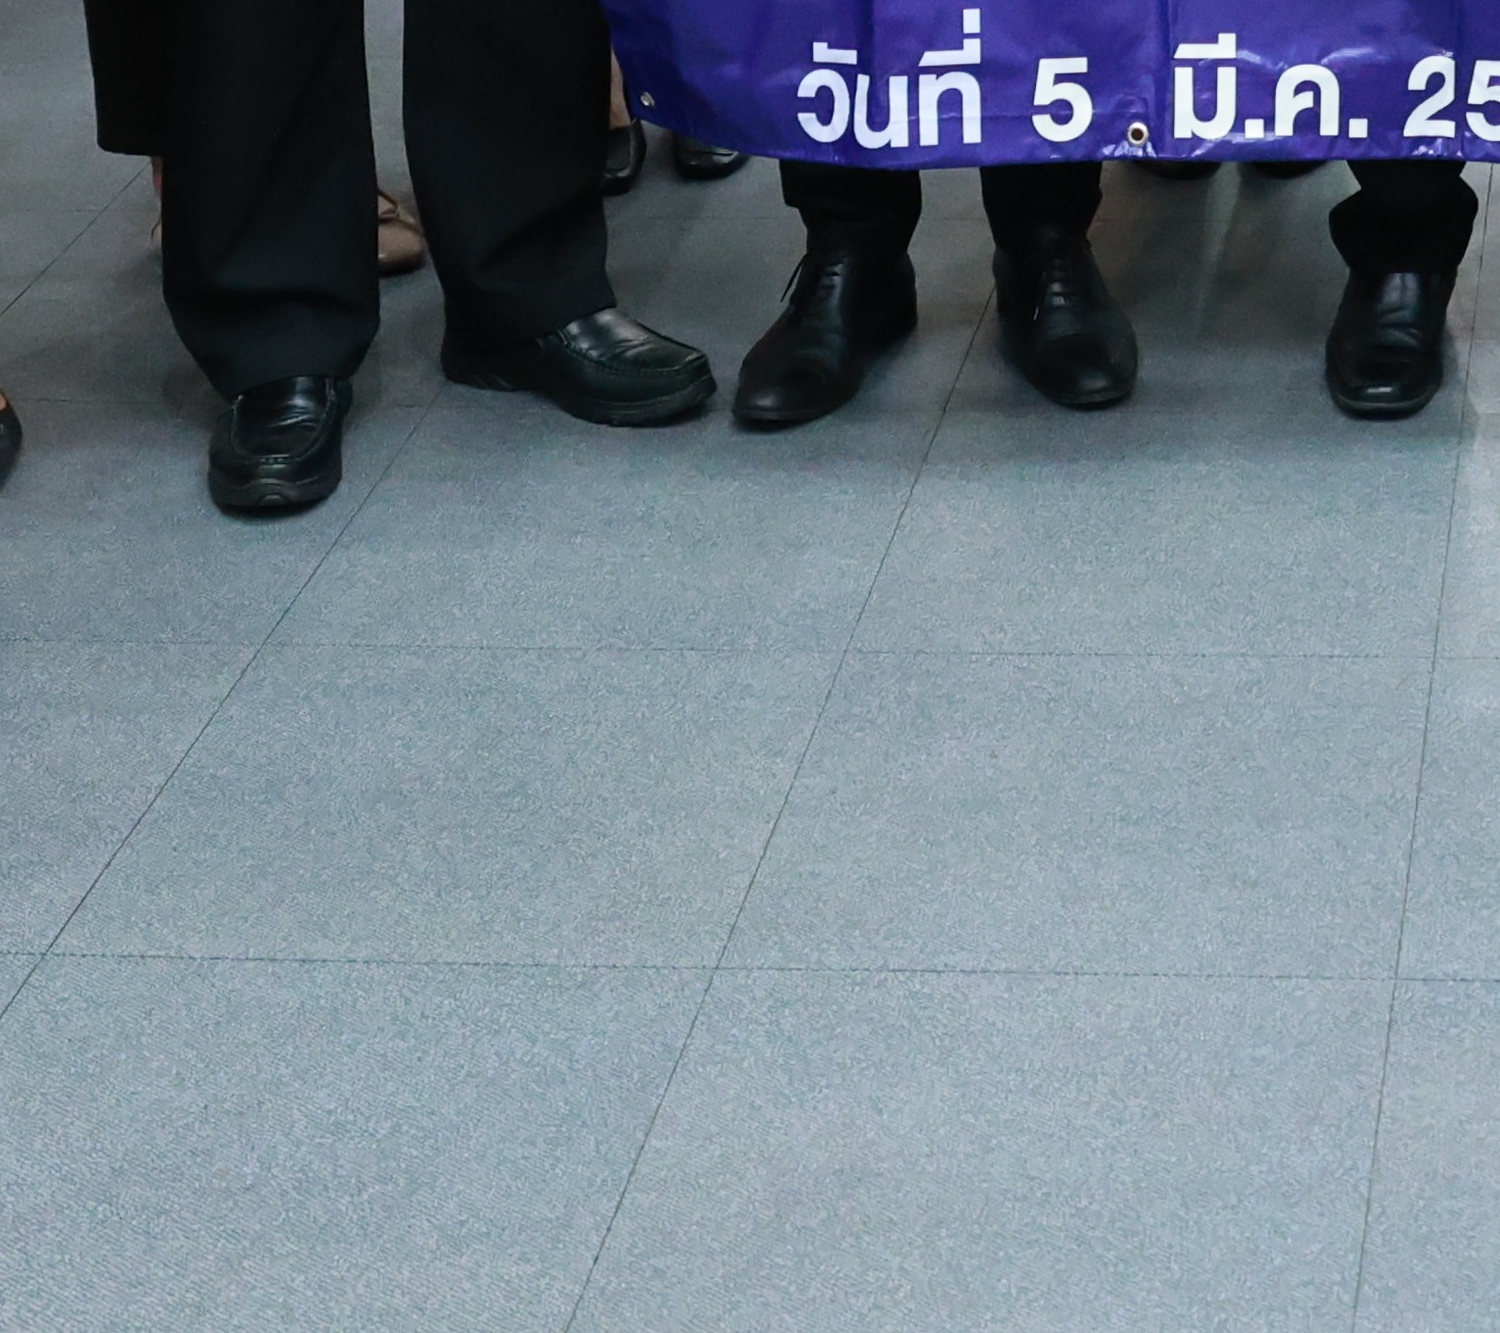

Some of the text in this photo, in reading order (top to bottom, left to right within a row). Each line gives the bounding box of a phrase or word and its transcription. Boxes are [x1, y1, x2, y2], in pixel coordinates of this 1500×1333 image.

[797, 8, 982, 149] วันที่
[1032, 57, 1094, 142] 5
[1173, 32, 1371, 140] มี.ค.
